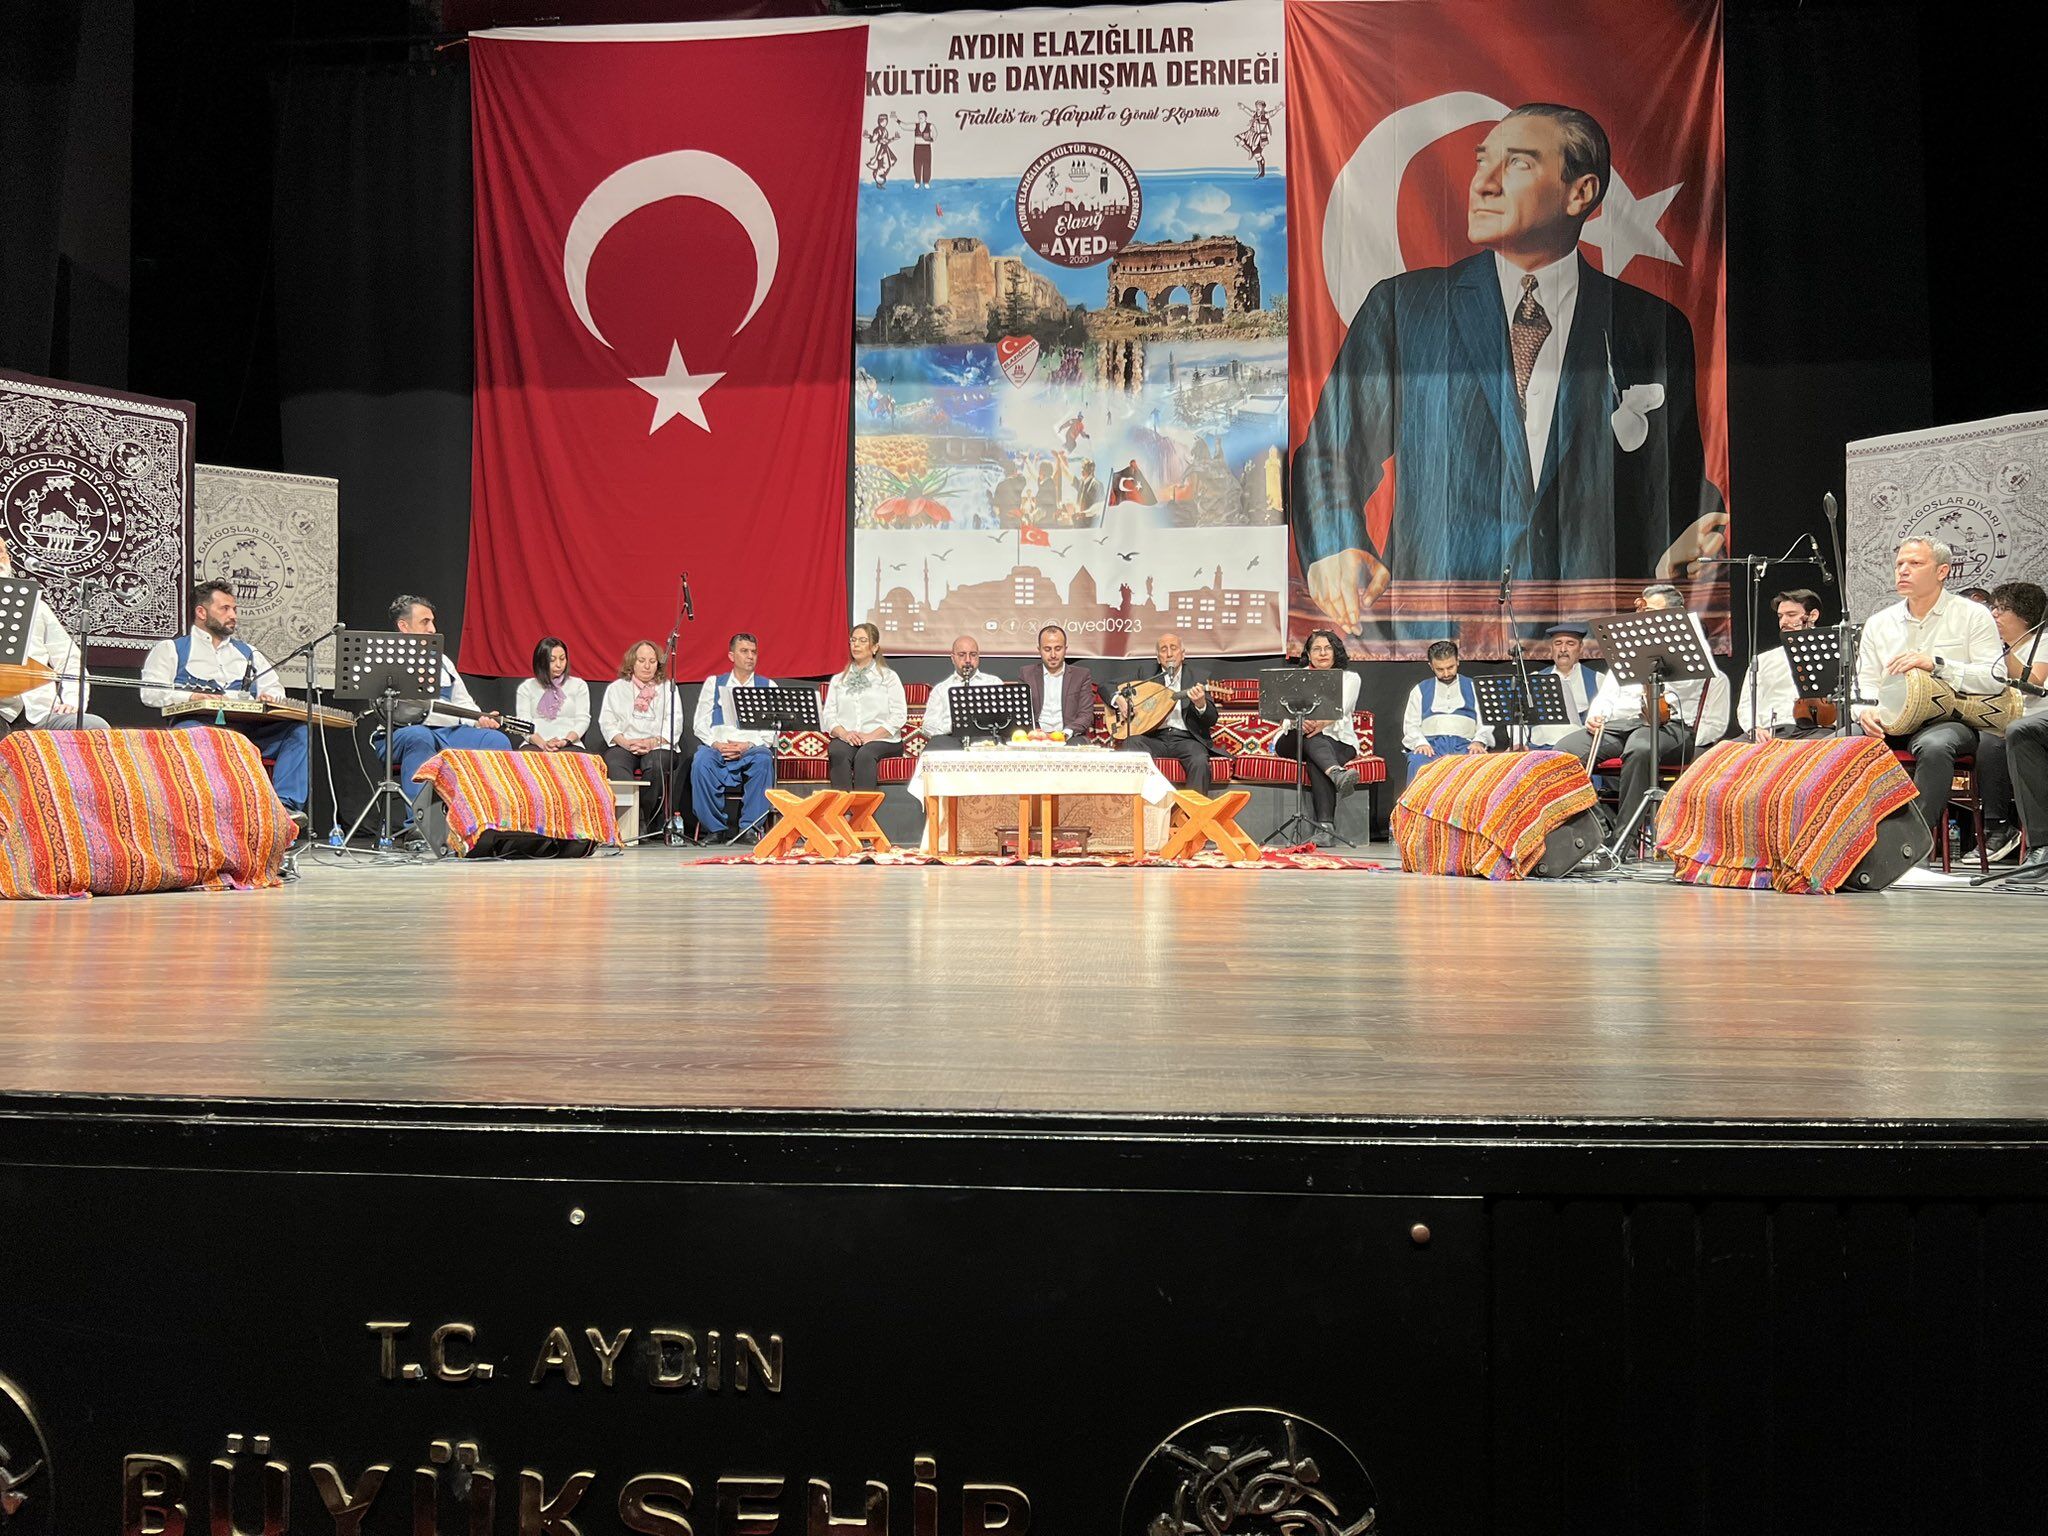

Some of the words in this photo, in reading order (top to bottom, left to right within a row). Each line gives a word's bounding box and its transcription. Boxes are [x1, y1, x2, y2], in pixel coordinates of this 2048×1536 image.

[948, 33, 1024, 60] AYDIN
[1033, 23, 1194, 57] ELAZIĞLILAR
[866, 63, 959, 97] KÜLTÜR
[968, 71, 997, 93] ve
[1005, 61, 1158, 95] DAYANIŞMA
[1167, 52, 1279, 87] DERNEĞİ
[1120, 106, 1159, 127] Gönül
[1161, 106, 1221, 126] Köprüsü
[1018, 208, 1031, 233] AYDIN
[1054, 211, 1105, 237] Elazığ
[1050, 236, 1108, 257] AYED
[240, 596, 285, 617] HATIRASI
[365, 1321, 494, 1382] T.C.
[529, 1325, 785, 1393] AYDIN
